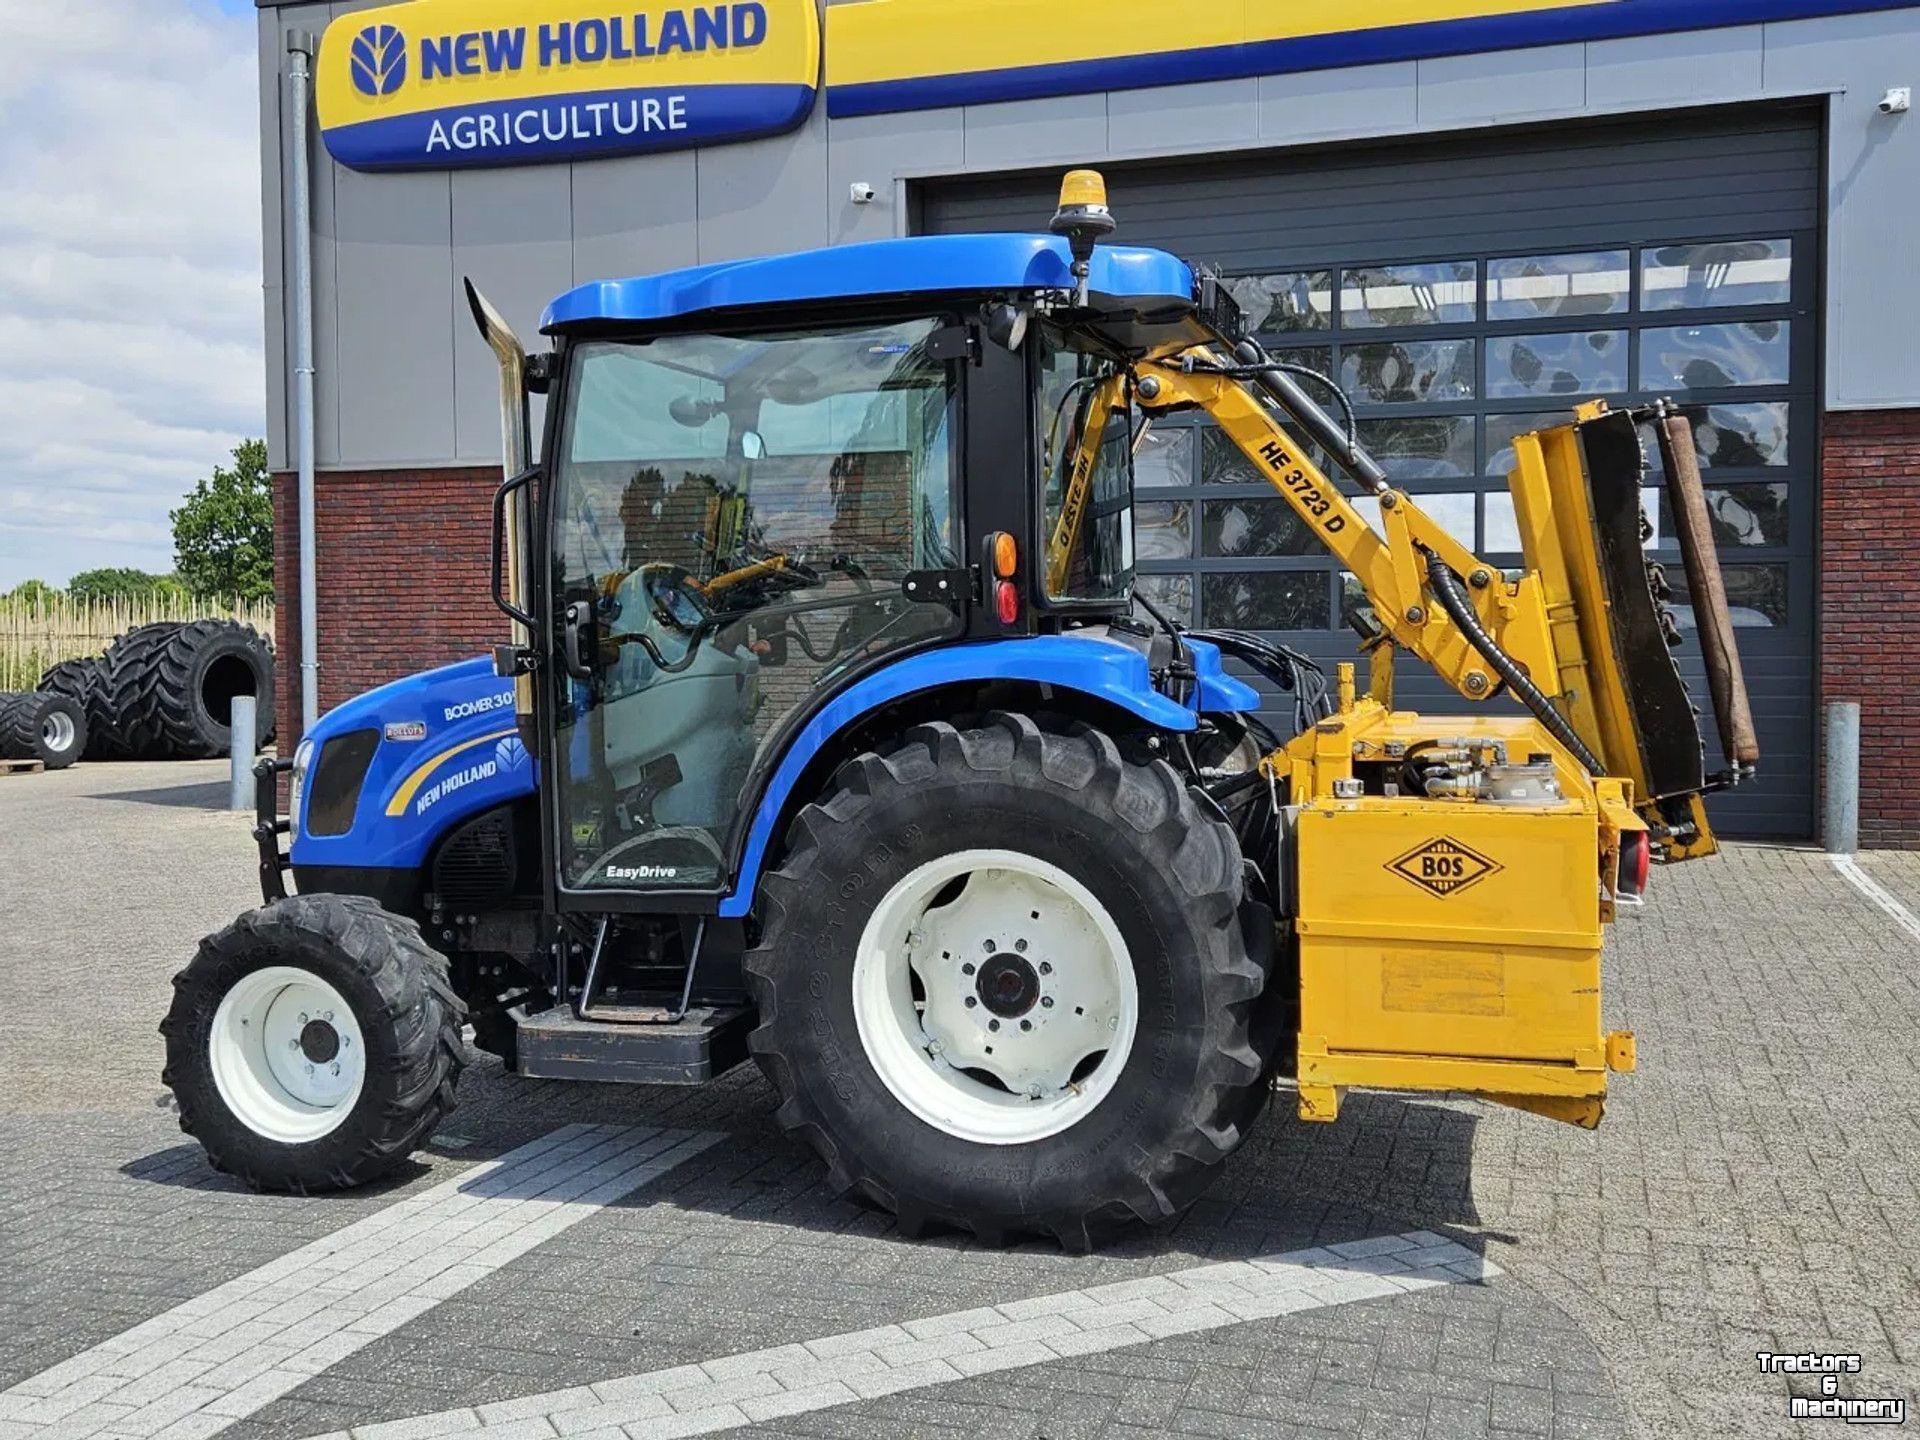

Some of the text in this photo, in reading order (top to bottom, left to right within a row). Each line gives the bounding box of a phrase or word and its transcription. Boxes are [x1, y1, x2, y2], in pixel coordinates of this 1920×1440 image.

[421, 1, 767, 80] NEW HOLLAND
[425, 95, 688, 153] AGRICULTURE
[1258, 440, 1347, 535] HE 3723 D
[443, 697, 494, 721] BOOMER
[416, 760, 497, 816] NEW HOLLAND
[606, 865, 677, 881] EasyDrive
[1422, 856, 1464, 877] BOS
